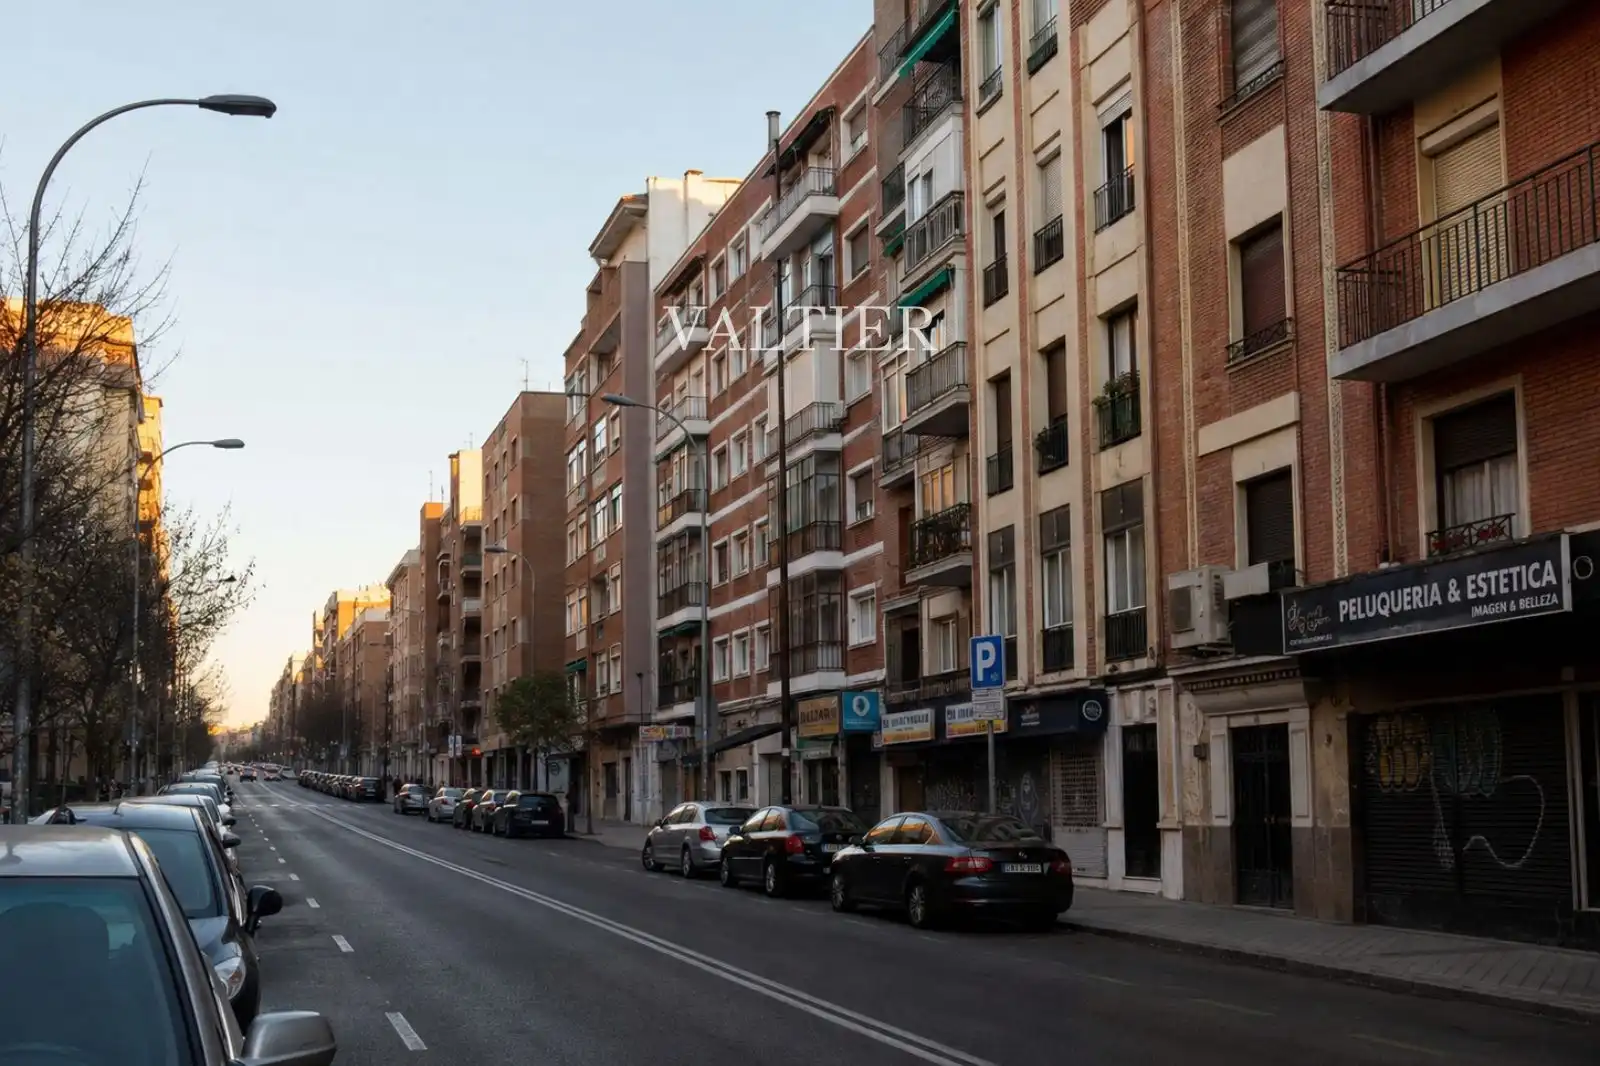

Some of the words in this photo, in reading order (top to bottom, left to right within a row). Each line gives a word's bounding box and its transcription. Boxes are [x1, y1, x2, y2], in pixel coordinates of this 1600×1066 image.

[1339, 583, 1442, 623] PELUQUERIA
[1448, 578, 1461, 602] &
[1466, 559, 1557, 600] ESTETICA
[1471, 601, 1507, 618] IMAGEN
[1509, 600, 1516, 612] &
[1519, 592, 1559, 611] BELLEZA
[976, 641, 996, 682] P
